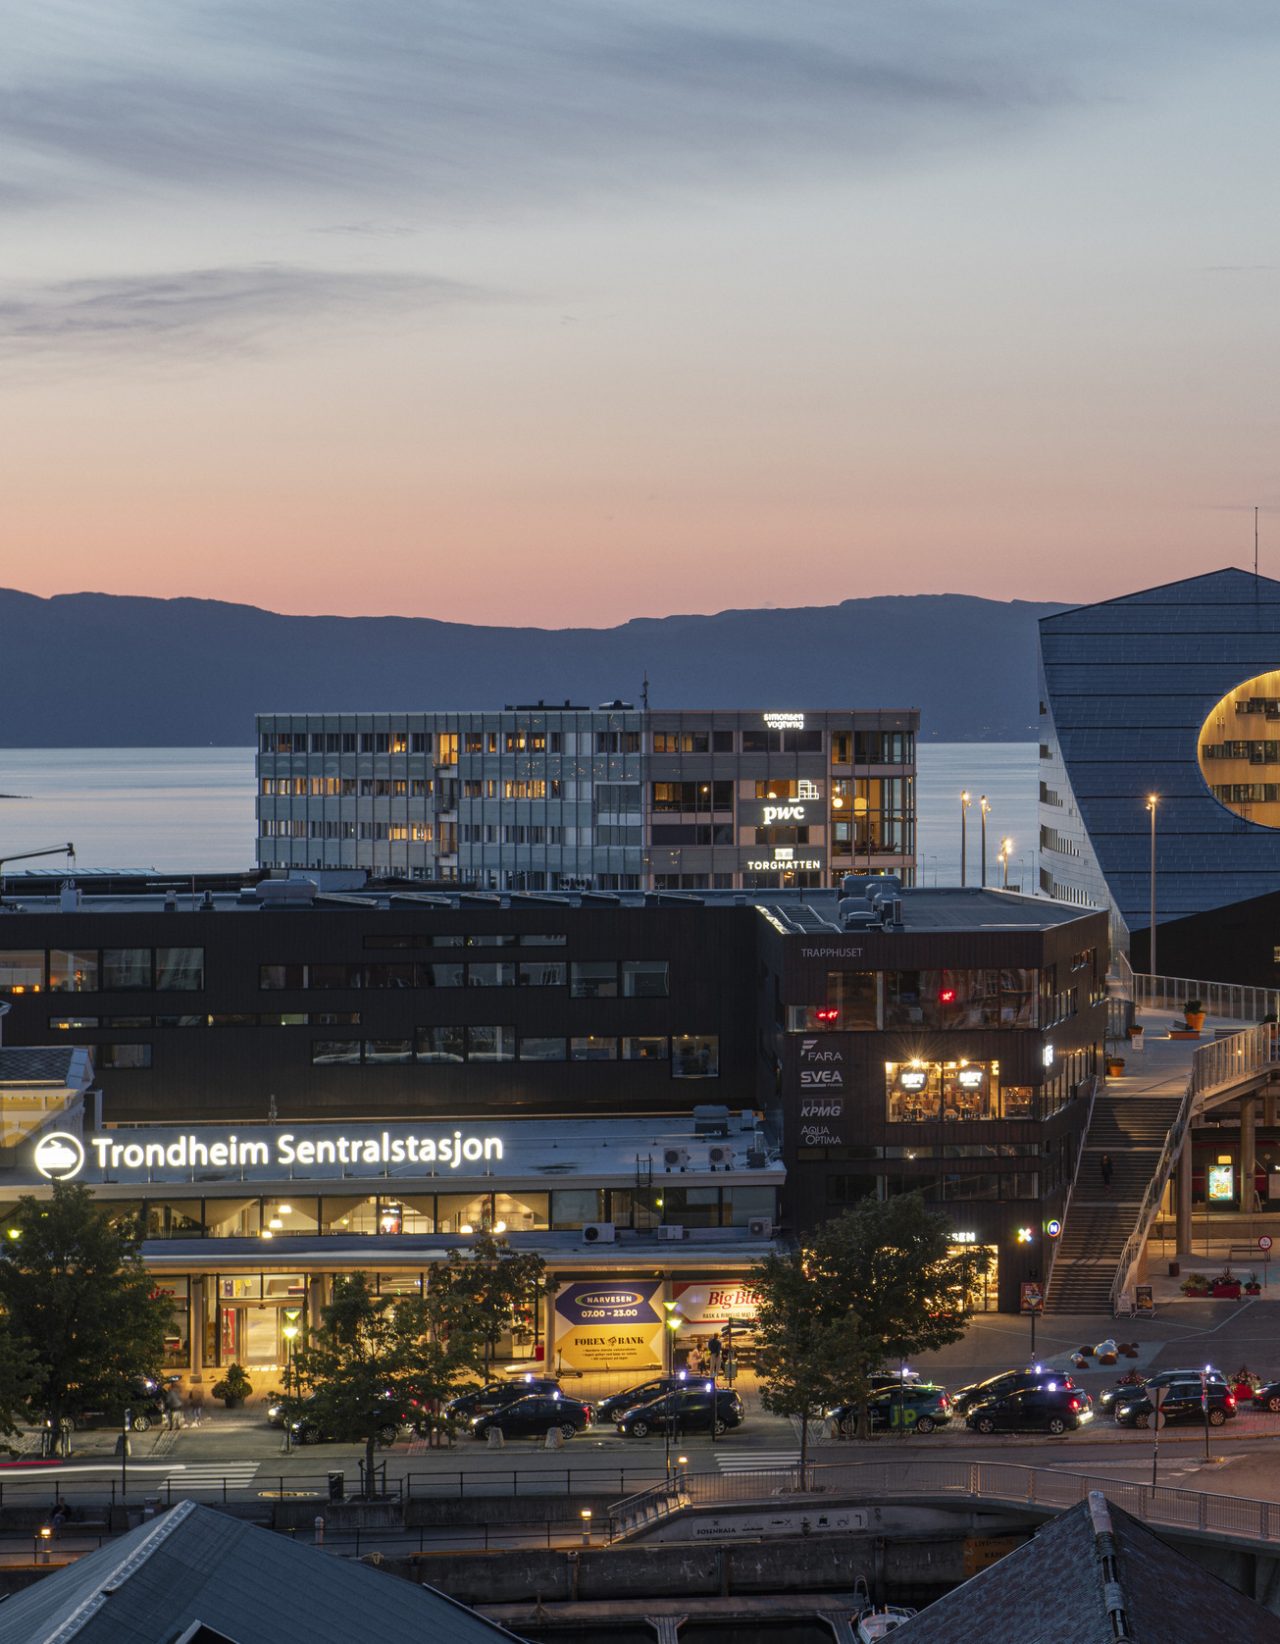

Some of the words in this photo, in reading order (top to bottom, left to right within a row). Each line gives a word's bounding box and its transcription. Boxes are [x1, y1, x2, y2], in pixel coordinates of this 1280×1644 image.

[763, 806, 805, 824] pwc
[748, 861, 820, 870] TORGHATTEN
[801, 948, 863, 958] TRAPPHUSET
[808, 1052, 843, 1061] FARA
[801, 1071, 843, 1083] SVEA
[801, 1105, 841, 1117] KPMG
[801, 1125, 829, 1136] AQUA
[805, 1134, 841, 1145] OPTIMA
[92, 1134, 270, 1168] Trondheim
[277, 1130, 504, 1168] Sentralstasjon
[586, 1295, 633, 1304] NARVESEN
[708, 1291, 733, 1309] Big
[581, 1309, 605, 1318] 07.00
[613, 1309, 638, 1317] 23.00
[574, 1338, 606, 1346] FOREX
[618, 1337, 645, 1345] BANK
